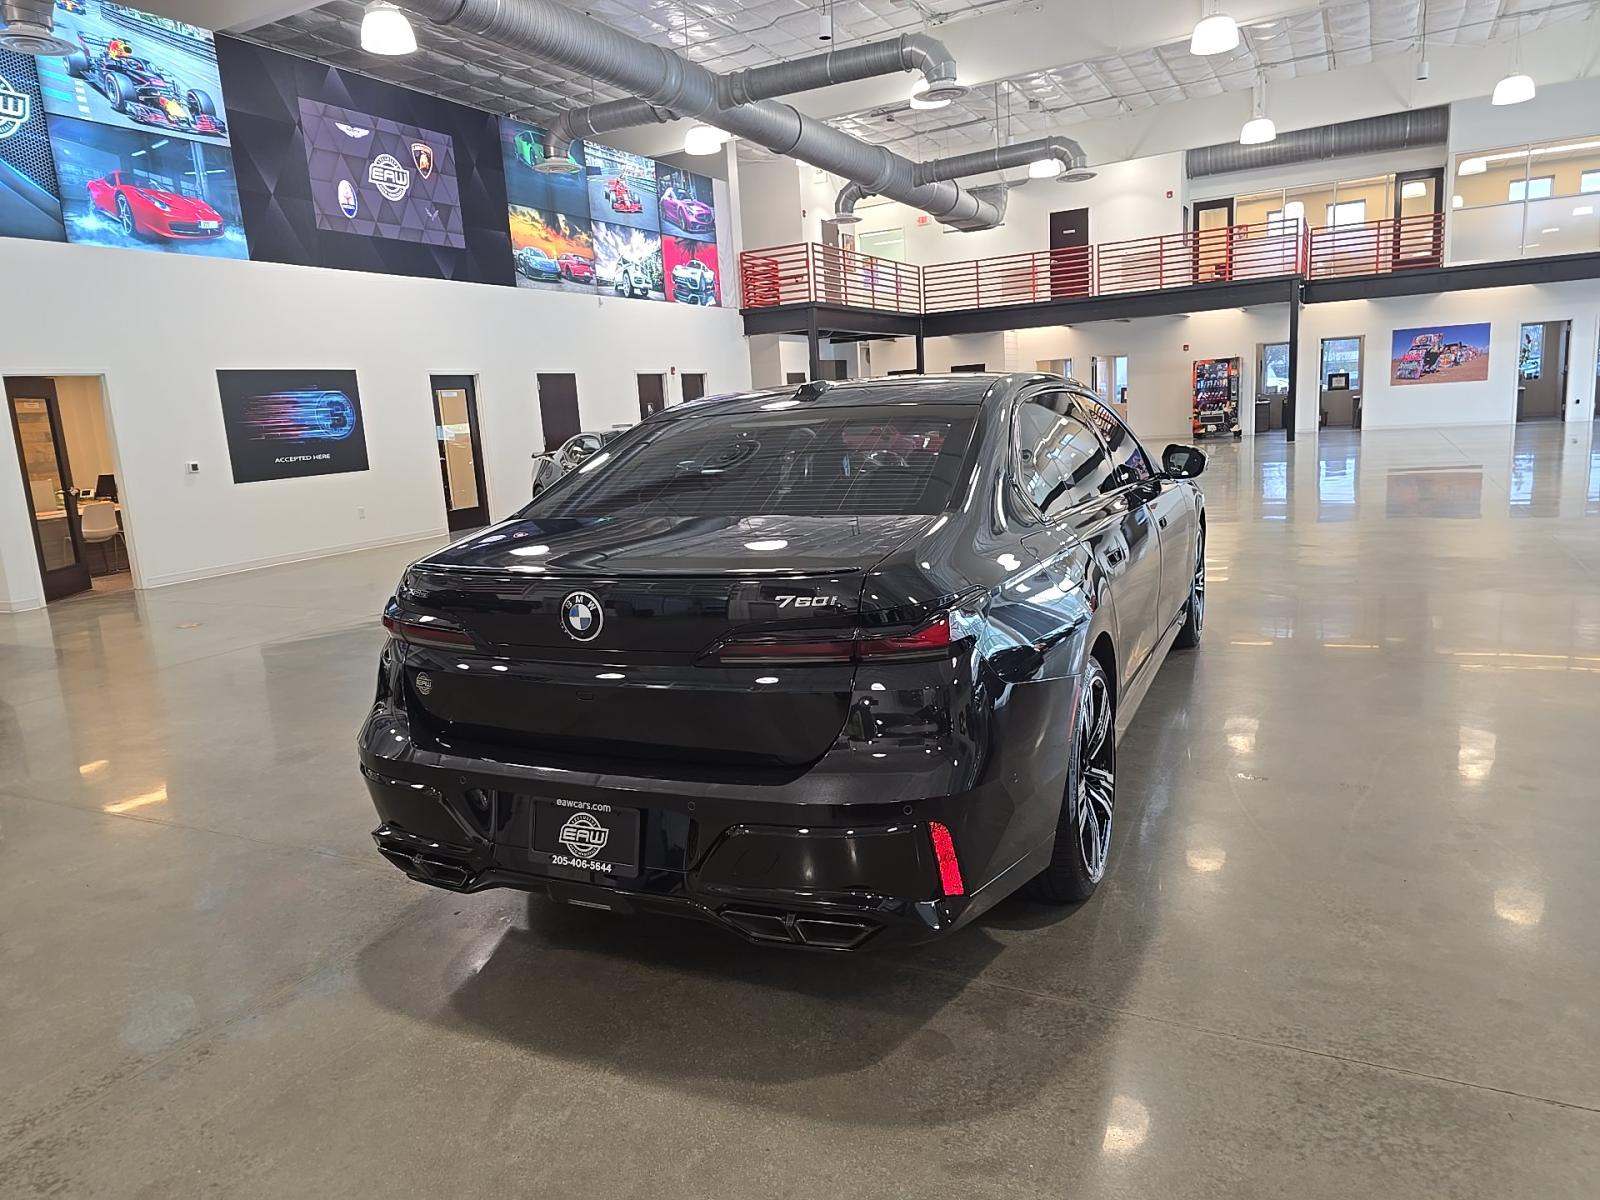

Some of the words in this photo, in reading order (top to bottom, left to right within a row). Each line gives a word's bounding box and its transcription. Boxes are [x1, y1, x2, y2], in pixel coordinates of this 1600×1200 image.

[371, 166, 408, 186] EAW
[274, 455, 312, 463] ACCEPTED
[564, 595, 597, 611] BMW
[556, 798, 611, 813] eawcars.com
[562, 827, 605, 844] EAW
[552, 855, 612, 873] 205-406-5644
